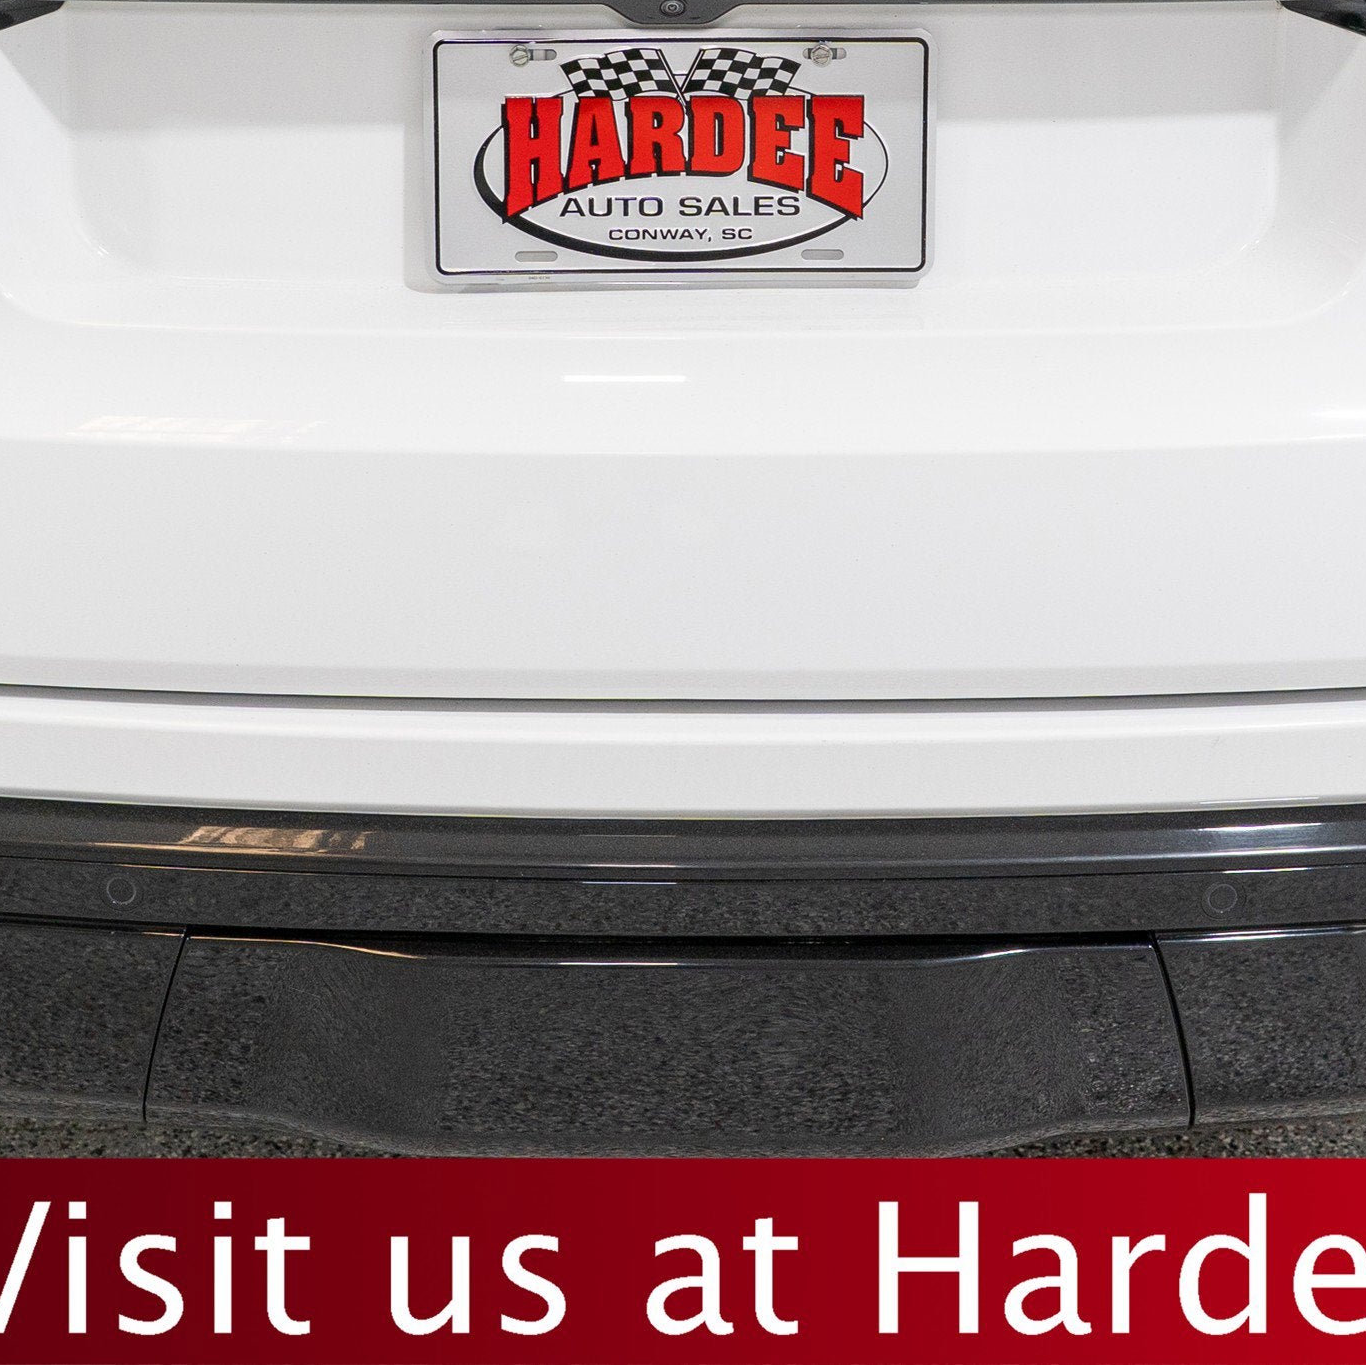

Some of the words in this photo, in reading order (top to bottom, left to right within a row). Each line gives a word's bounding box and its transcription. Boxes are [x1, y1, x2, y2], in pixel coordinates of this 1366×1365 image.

[502, 95, 865, 222] HARDEE
[559, 196, 664, 218] AUTO
[678, 196, 800, 217] SALES
[608, 228, 713, 243] CONWAY,
[721, 228, 753, 241] SC
